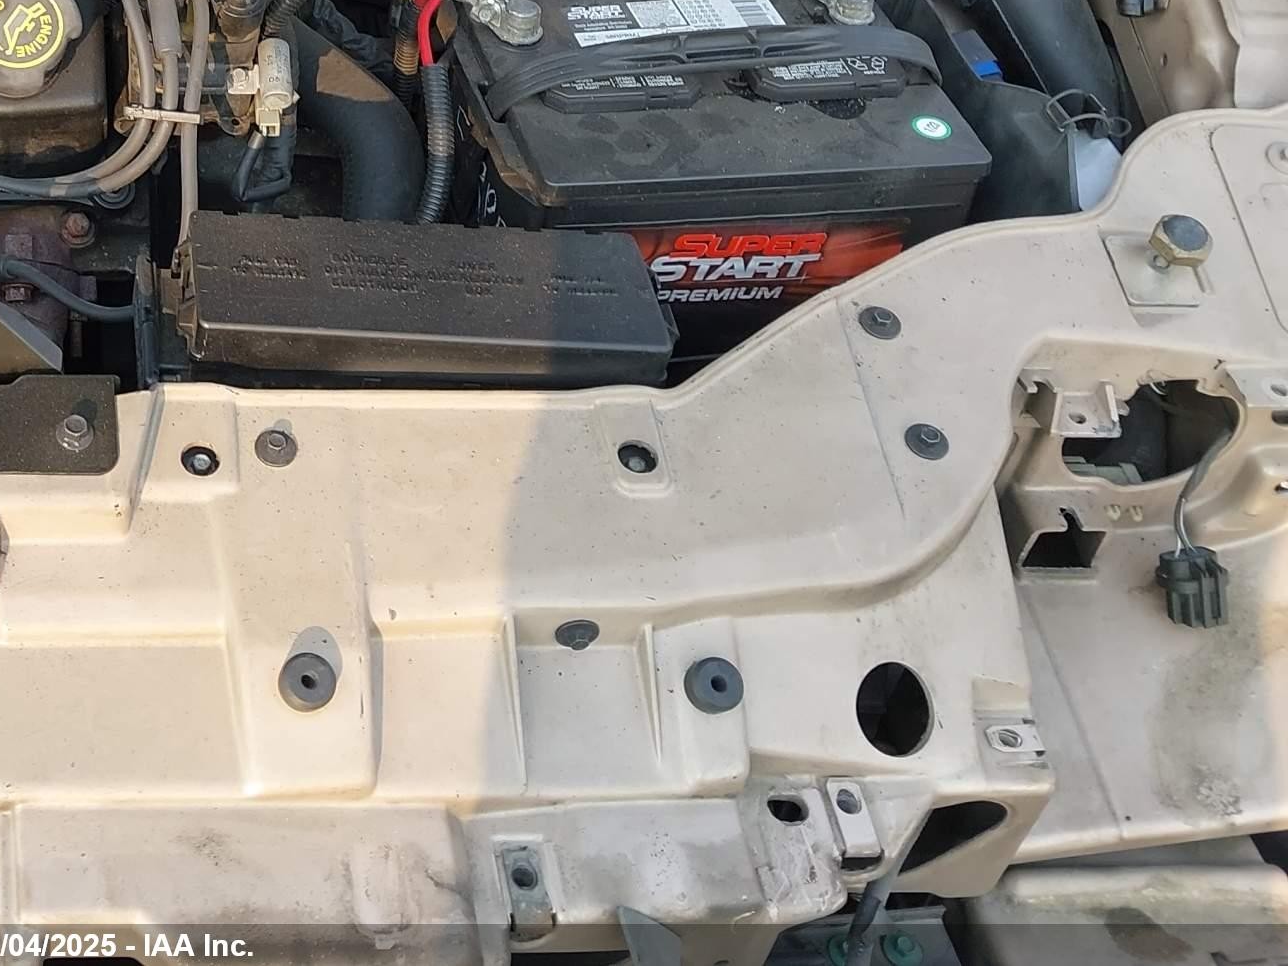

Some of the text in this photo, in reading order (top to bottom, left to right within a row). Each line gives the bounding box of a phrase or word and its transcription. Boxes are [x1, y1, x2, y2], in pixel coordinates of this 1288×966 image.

[15, 15, 52, 58] ENGINE
[669, 233, 827, 258] SUPER
[649, 253, 822, 283] START
[657, 286, 784, 303] PREMIUM
